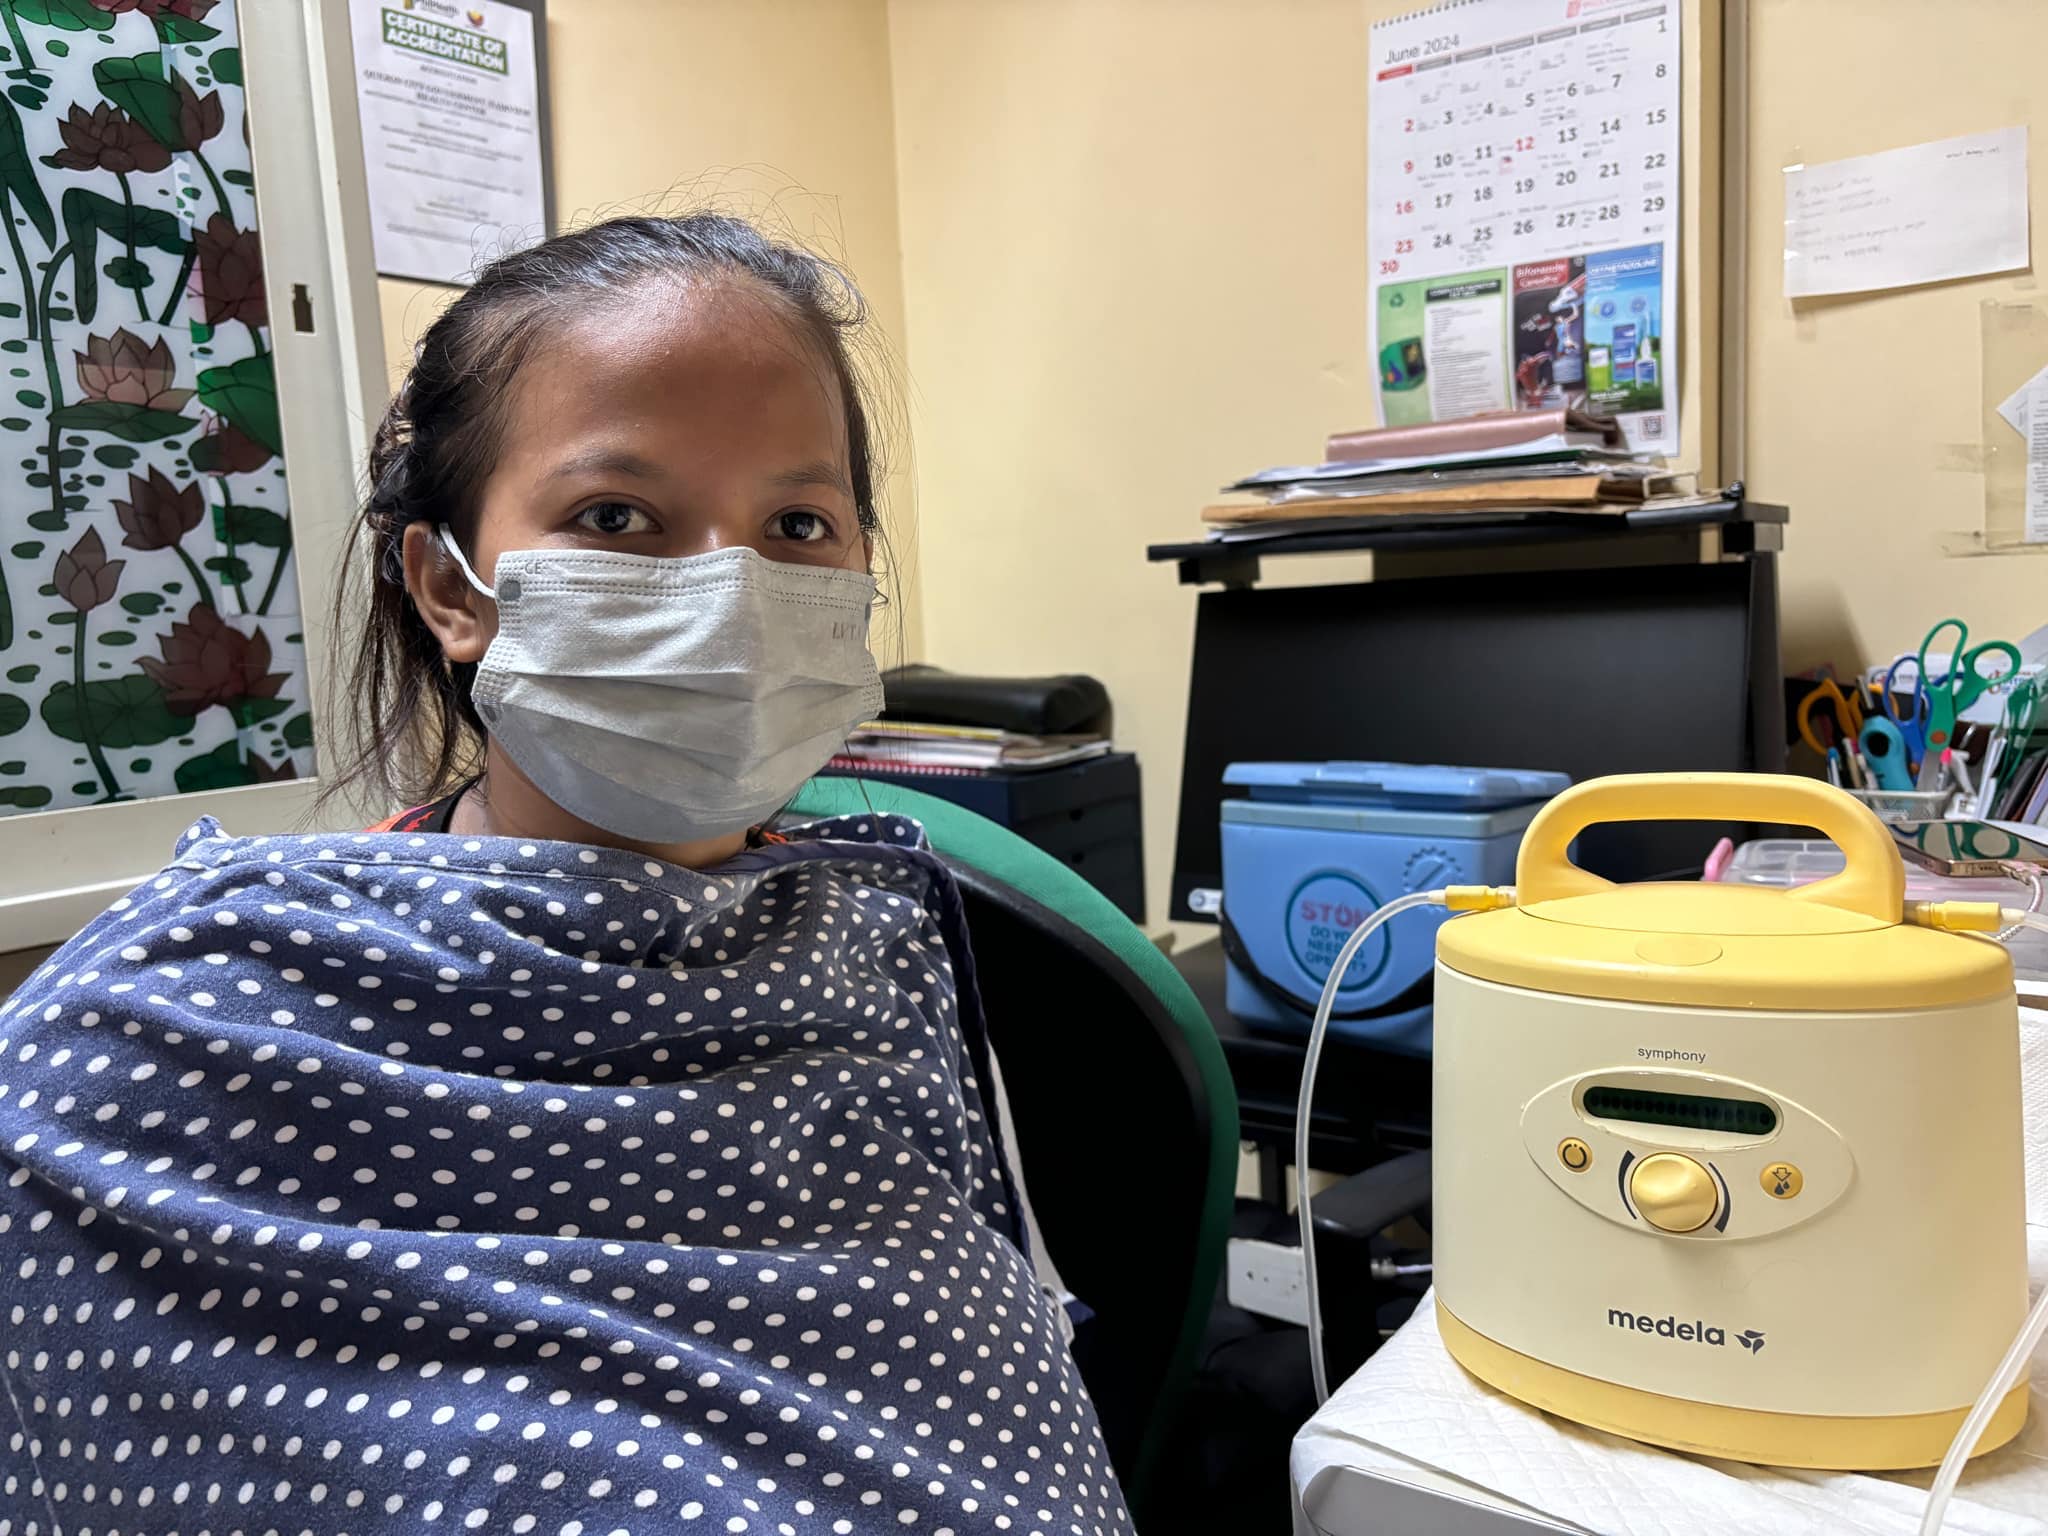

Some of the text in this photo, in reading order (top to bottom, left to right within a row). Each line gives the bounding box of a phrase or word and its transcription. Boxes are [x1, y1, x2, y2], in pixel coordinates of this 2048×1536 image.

[385, 11, 504, 56] CERTIFICATE OF
[1658, 19, 1667, 33] 1
[387, 28, 505, 71] ACCREDITATION
[1385, 46, 1420, 64] June
[1423, 34, 1460, 56] 2024
[1404, 63, 1667, 133] 2 3 4 5 6 7 8
[1404, 108, 1667, 174] 9 10 11 12 13 14 15
[1396, 153, 1666, 215] 16 17 18 19 20 21 22
[1395, 196, 1666, 254] 23 24 25 26 27 28 29
[1380, 259, 1399, 274] 30
[1637, 1047, 1706, 1065] symphony
[1608, 1308, 1726, 1346] medela
